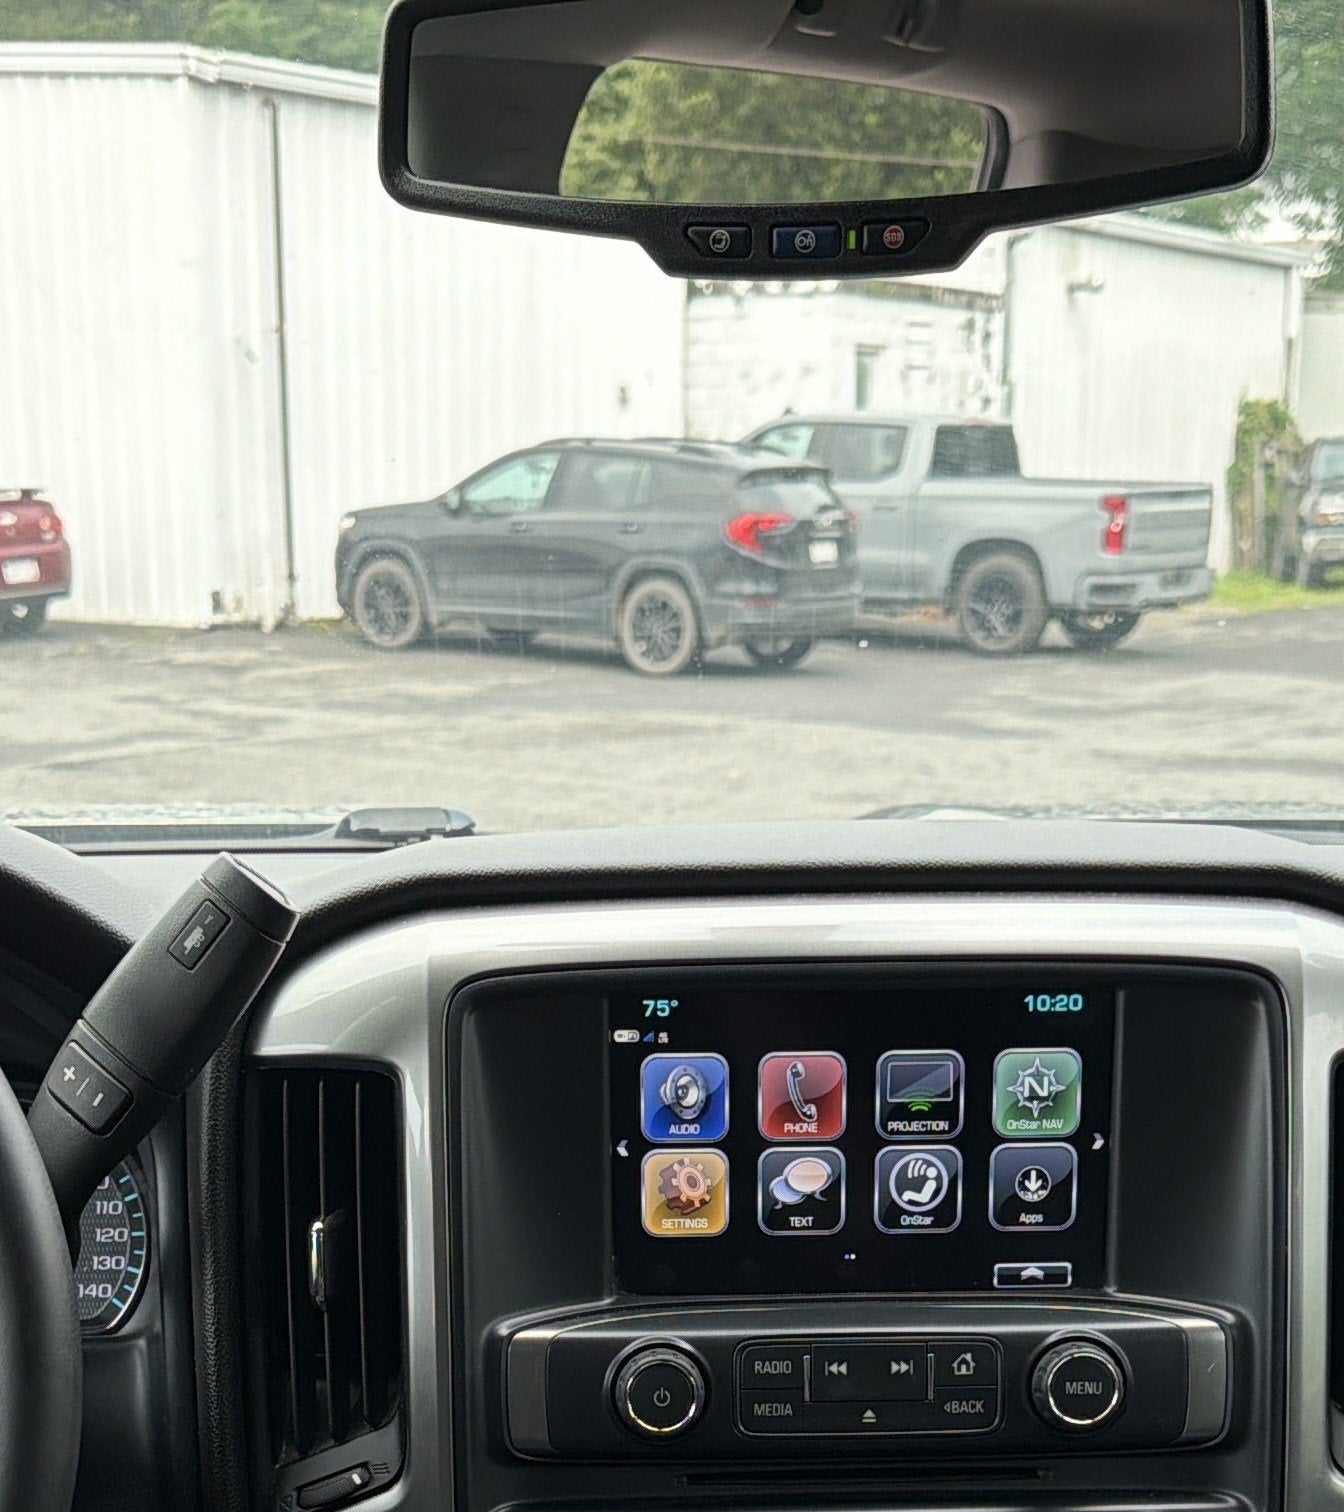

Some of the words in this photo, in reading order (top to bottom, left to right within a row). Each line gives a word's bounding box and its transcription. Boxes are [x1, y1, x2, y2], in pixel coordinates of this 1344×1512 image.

[1024, 993, 1083, 1013] 10:20
[668, 1123, 701, 1135] AUDIO
[783, 1122, 818, 1134] PHONE
[887, 1120, 949, 1132] PROJECTION
[1006, 1118, 1041, 1130] OnStar
[1042, 1118, 1064, 1130] NAV
[95, 1201, 123, 1215] 110
[661, 1218, 709, 1229] SETTINGS
[789, 1216, 813, 1227] TEXT
[900, 1214, 934, 1226] OnStar
[1019, 1212, 1044, 1225] Apps
[95, 1228, 129, 1242] 120
[92, 1256, 126, 1270] 130
[77, 1284, 113, 1298] 140
[754, 1360, 792, 1375] RADIO
[1065, 1381, 1103, 1395] MENU
[753, 1403, 793, 1417] MEDIA
[951, 1400, 984, 1413] BACK
